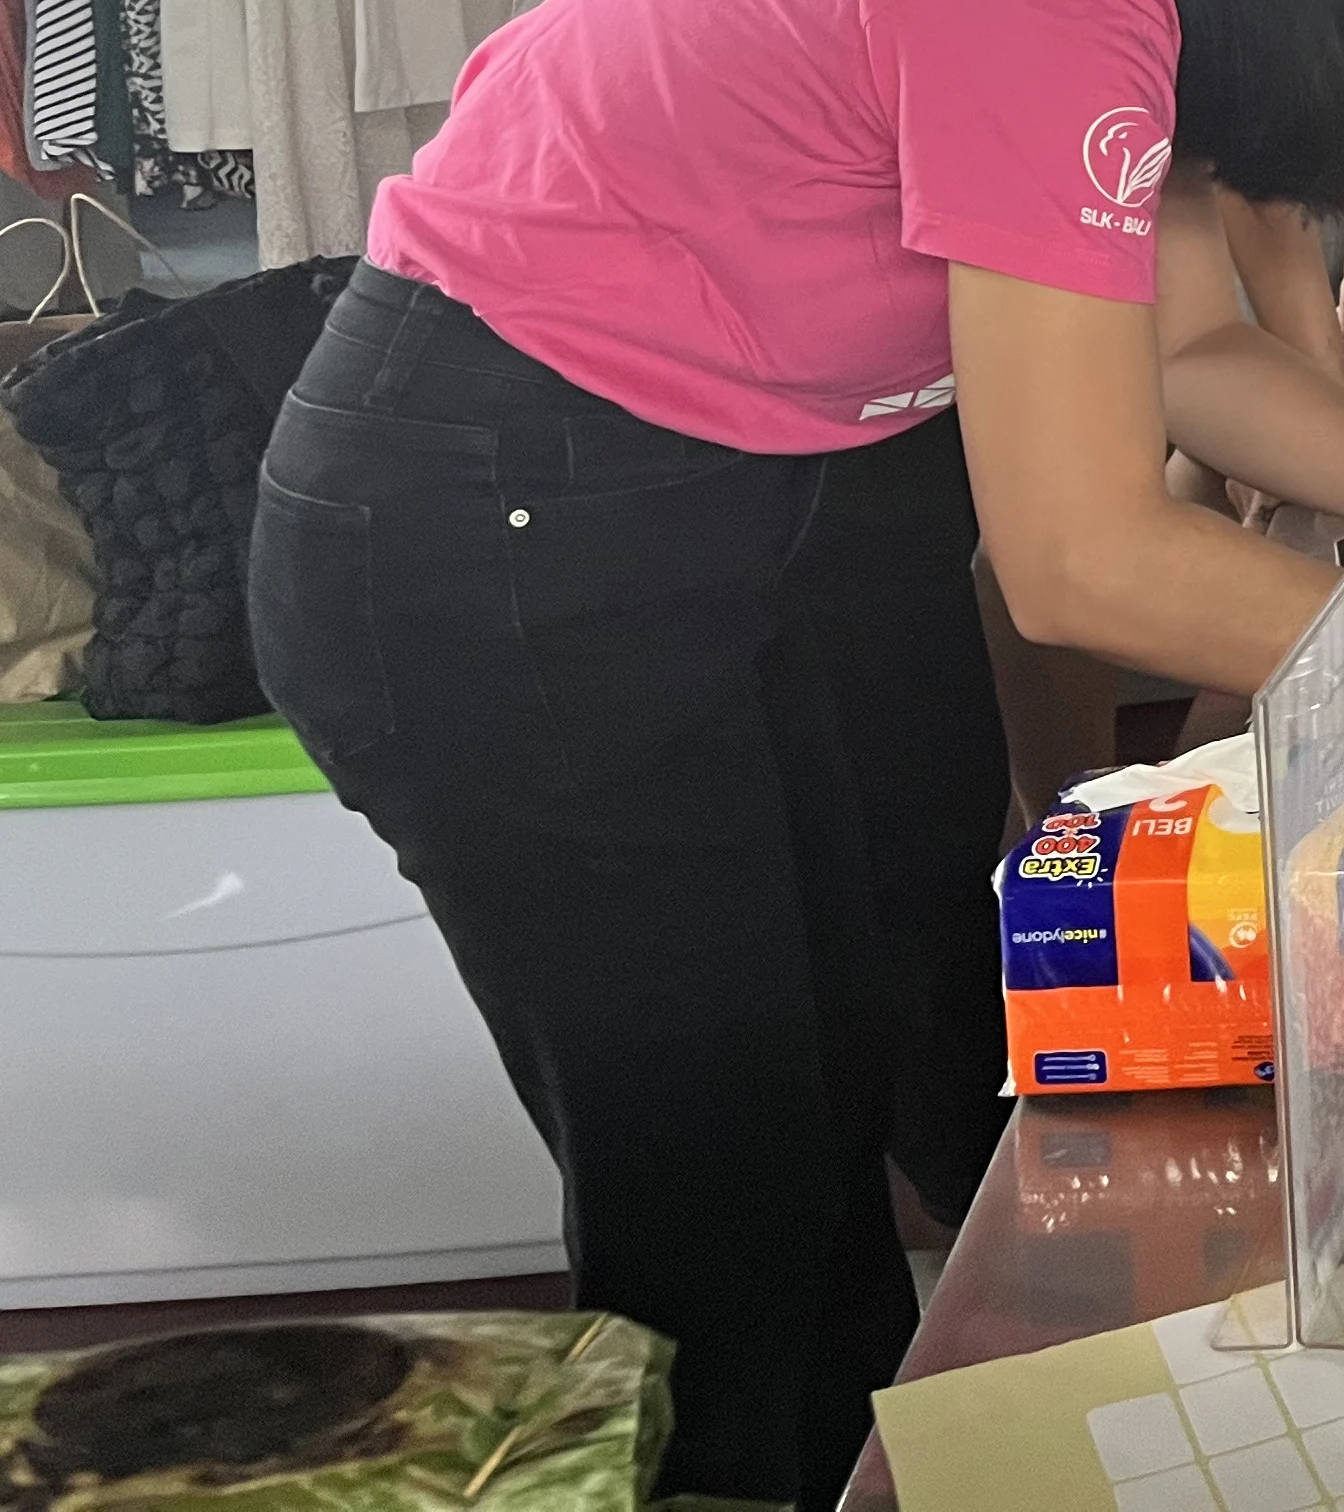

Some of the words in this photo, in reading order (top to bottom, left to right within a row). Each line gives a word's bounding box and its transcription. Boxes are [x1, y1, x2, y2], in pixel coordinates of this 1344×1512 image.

[1132, 817, 1193, 836] BELI
[1034, 835, 1099, 856] 400
[1023, 856, 1098, 878] Extra
[1012, 929, 1107, 944] #nicelydone
